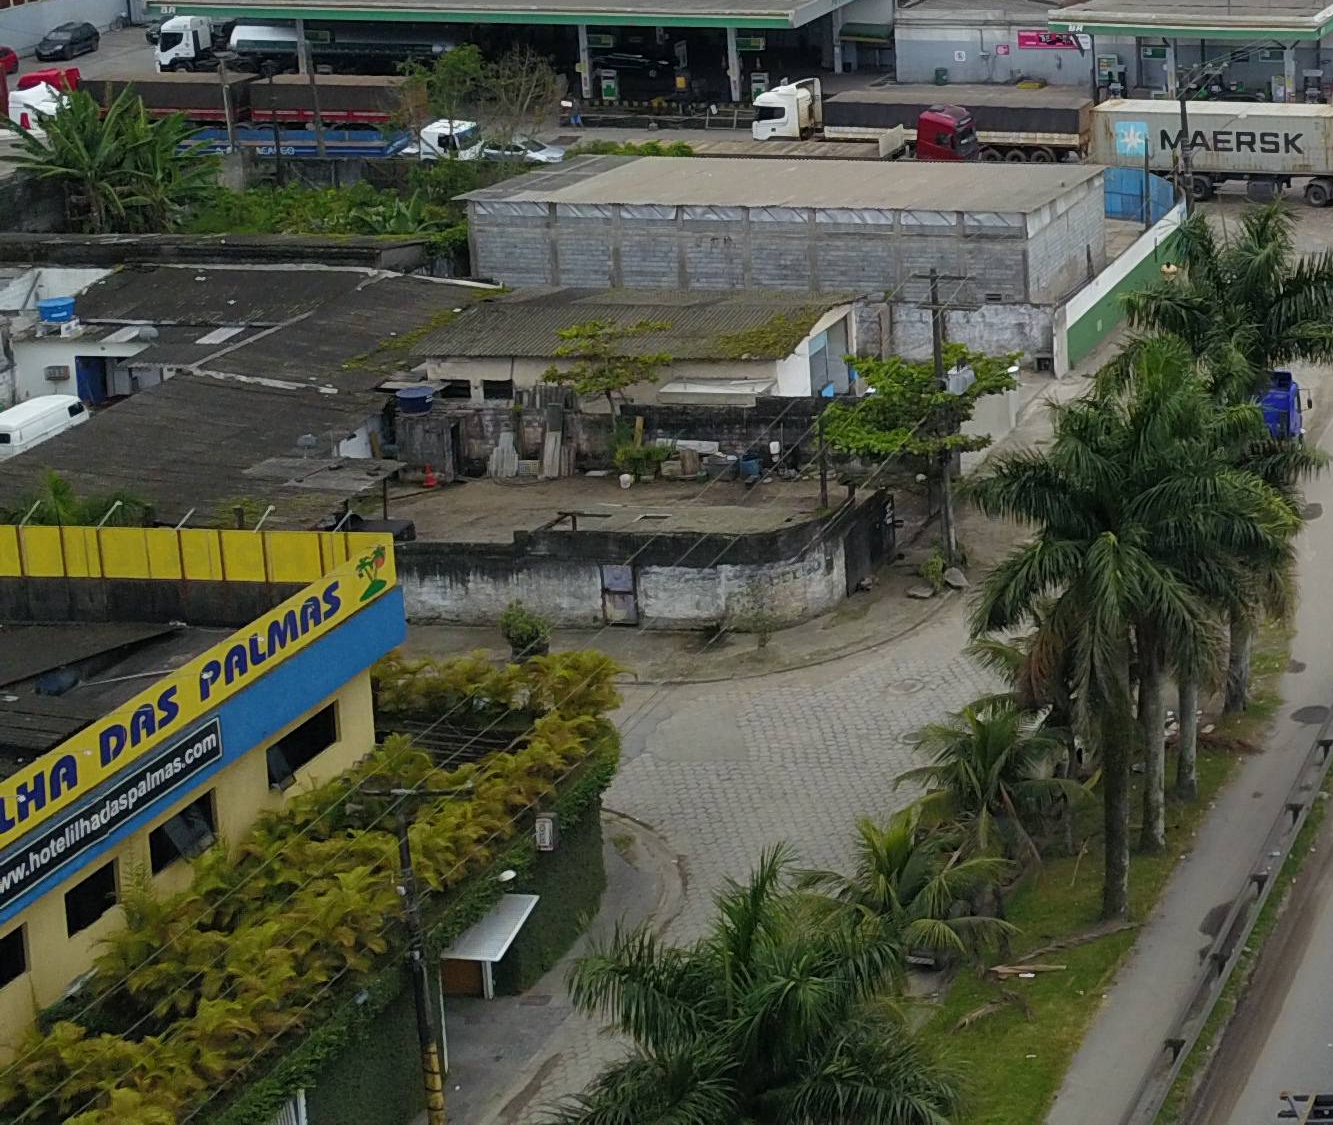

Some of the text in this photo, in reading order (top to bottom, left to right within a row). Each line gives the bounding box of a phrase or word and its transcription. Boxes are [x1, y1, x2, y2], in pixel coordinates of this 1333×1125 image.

[1160, 129, 1304, 155] MAERSK
[100, 685, 180, 768] DAS
[199, 580, 342, 702] PALMAS
